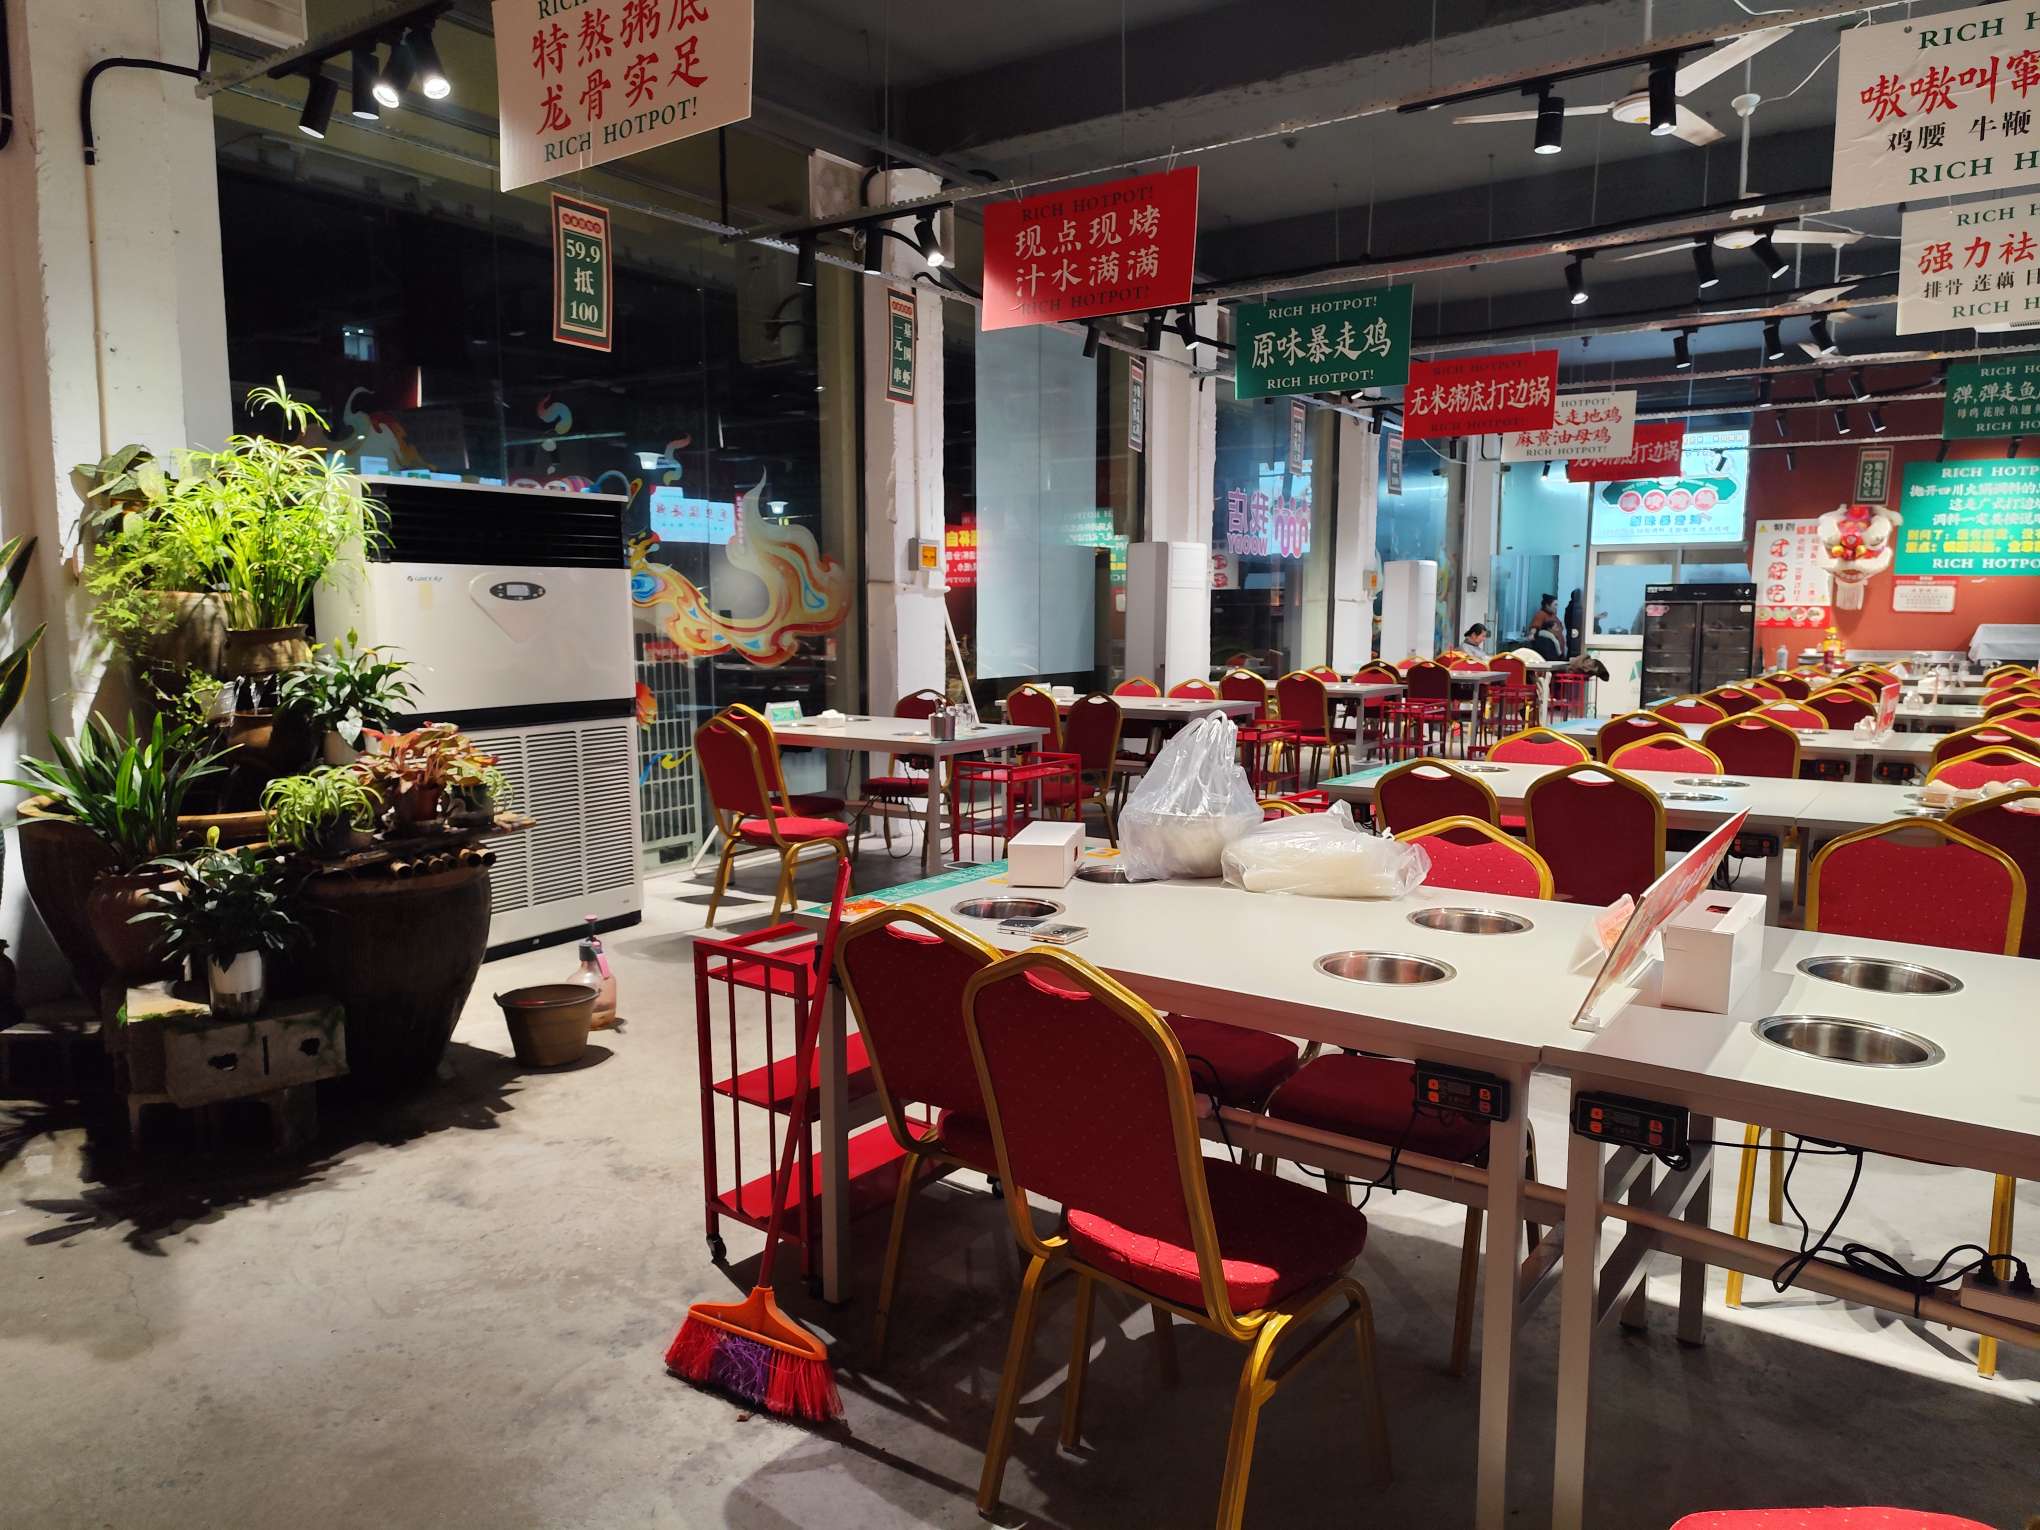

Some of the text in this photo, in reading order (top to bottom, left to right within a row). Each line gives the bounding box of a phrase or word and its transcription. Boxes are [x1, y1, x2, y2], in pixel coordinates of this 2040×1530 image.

[538, 0, 588, 20] RIC
[532, 0, 709, 79] 特熬粥底
[1918, 17, 2004, 50] RICH
[537, 35, 708, 135] 龙骨实足
[544, 97, 698, 162] RICH HOTPOT!
[1886, 109, 2032, 154] 鸡腰 牛鞭
[1909, 157, 1993, 186] RICH
[1023, 186, 1152, 221] RICH HOTPOT!
[1956, 206, 2016, 227] RICH
[1016, 204, 1161, 260] 现点现烤
[565, 239, 600, 264] 59.9
[1918, 231, 2038, 275] 强力祛
[574, 266, 594, 296] 抵
[1016, 244, 1160, 297] 汁水满满
[1923, 278, 1963, 299] 排骨
[569, 300, 599, 324] 100
[1268, 296, 1378, 320] RICH HOTPOT!
[1952, 300, 2009, 318] RICH
[1251, 316, 1392, 369] 原味暴走鸡
[1267, 369, 1375, 390] RICH HOTPOT!
[1981, 366, 2017, 377] RICH
[1409, 375, 1551, 416] 无米粥底打边锅
[1561, 398, 1610, 408] HOTPOT!
[1515, 426, 1612, 447] 麻黄油母鸡
[1976, 422, 2012, 432] RICH
[1526, 446, 1607, 457] RICH HOTPOT!
[1941, 467, 1983, 478] RICH
[1932, 559, 1974, 569] RICH
